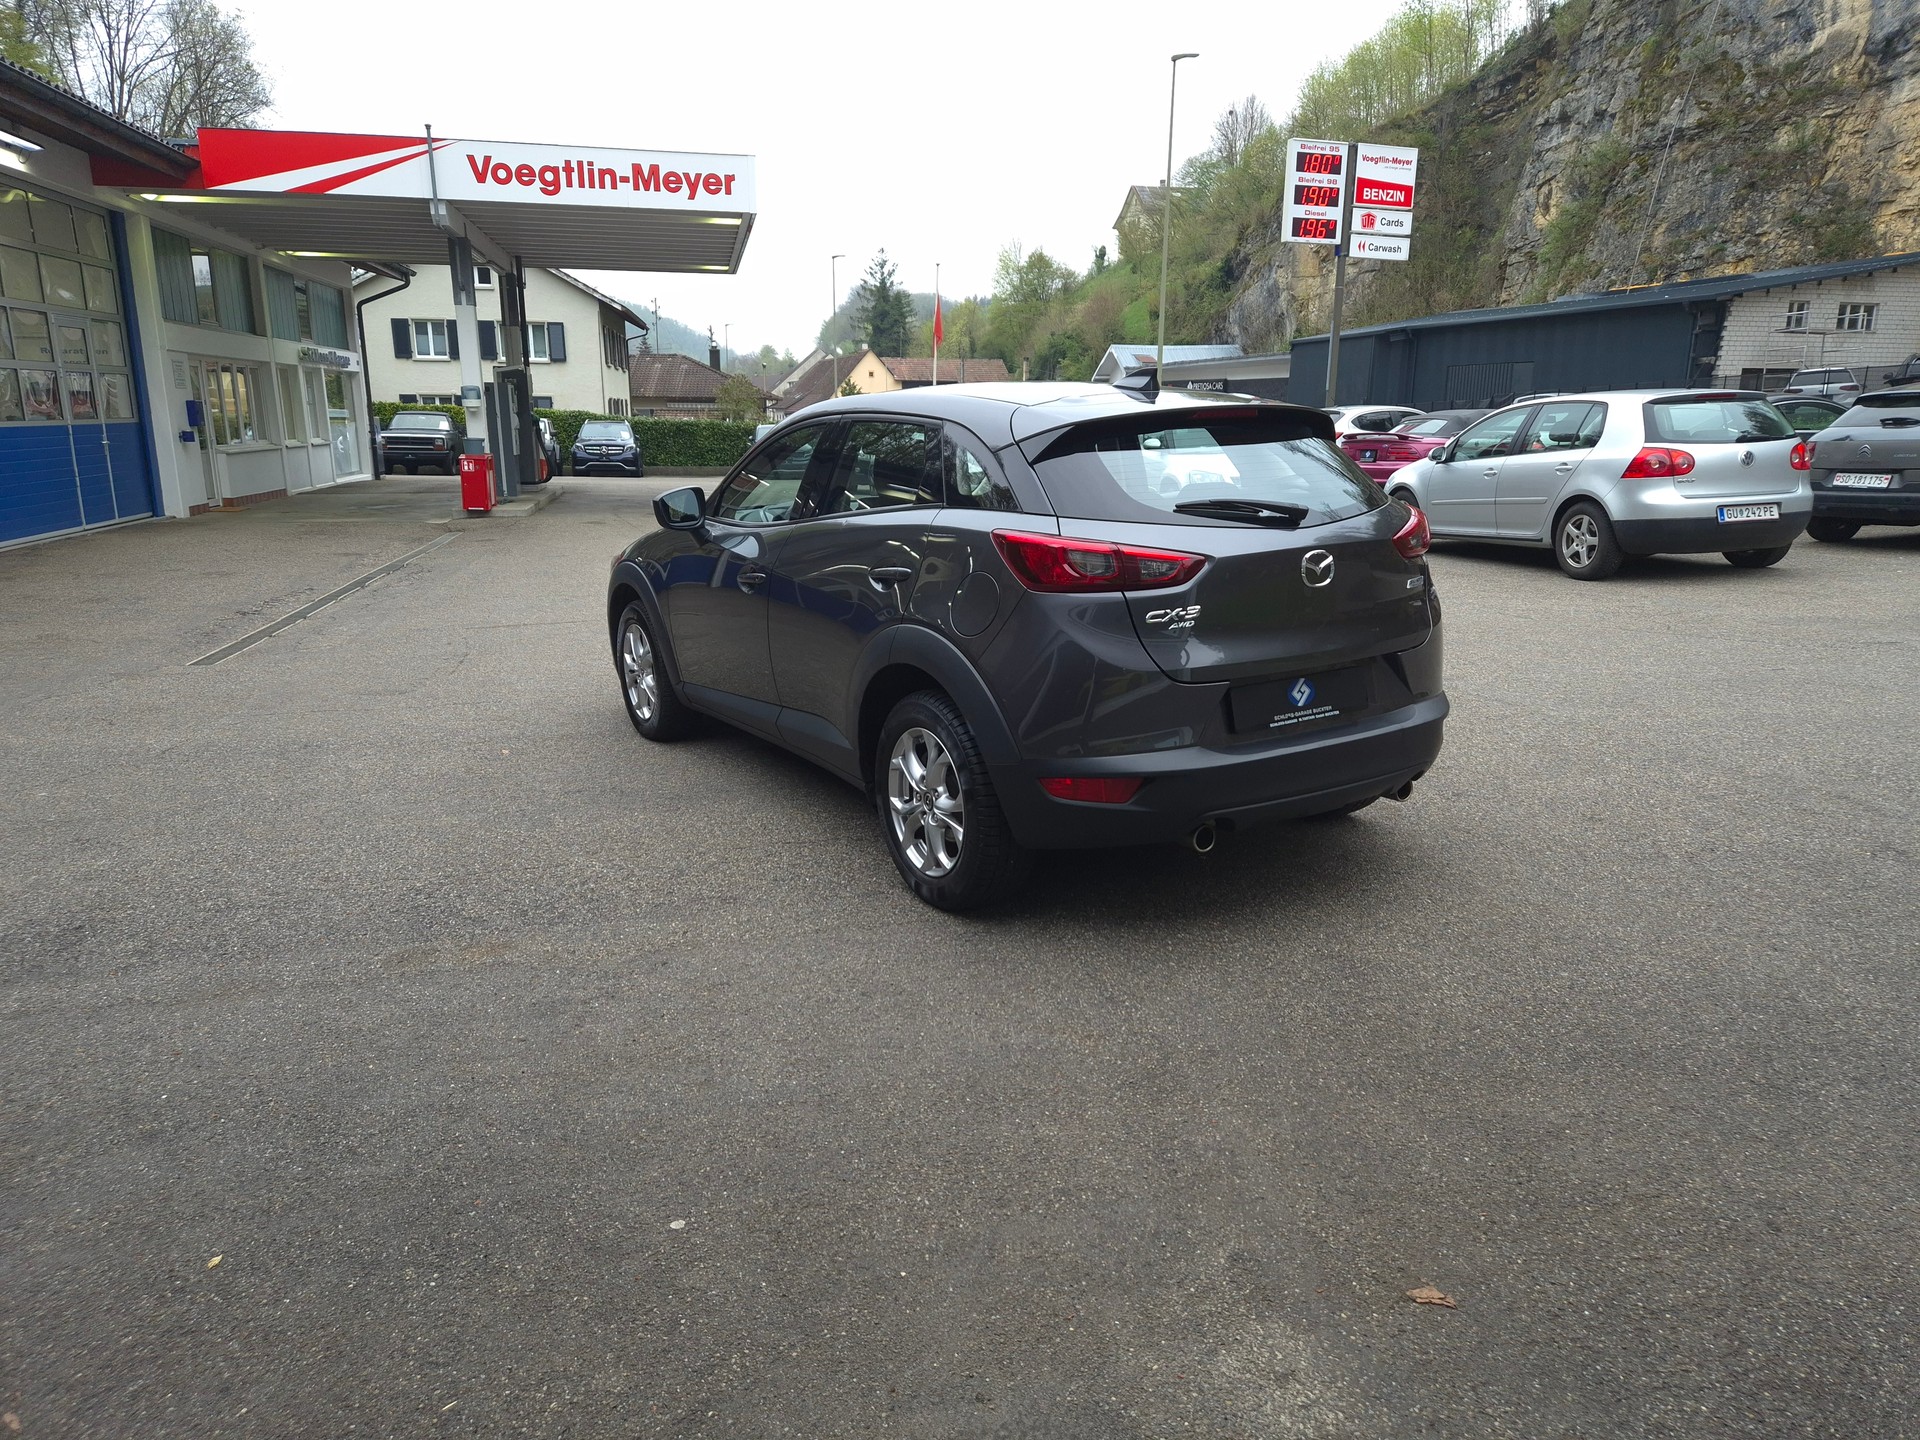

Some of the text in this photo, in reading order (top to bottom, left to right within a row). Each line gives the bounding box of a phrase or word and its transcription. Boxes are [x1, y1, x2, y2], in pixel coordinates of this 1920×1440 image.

[1300, 143, 1340, 153] Bleifrei 95
[1361, 154, 1413, 167] Voegtlin-Meyer
[466, 154, 736, 201] Voegtlin-Meyer
[1298, 176, 1338, 186] Bleifrei 98
[1363, 187, 1406, 203] BENZIN
[1304, 209, 1327, 217] Diesel
[1380, 217, 1405, 228] Cards
[1368, 242, 1402, 254] Carwash
[1212, 382, 1223, 390] CARS
[1726, 506, 1740, 519] GU
[1145, 605, 1201, 624] CX-3
[1168, 620, 1195, 630] AWD
